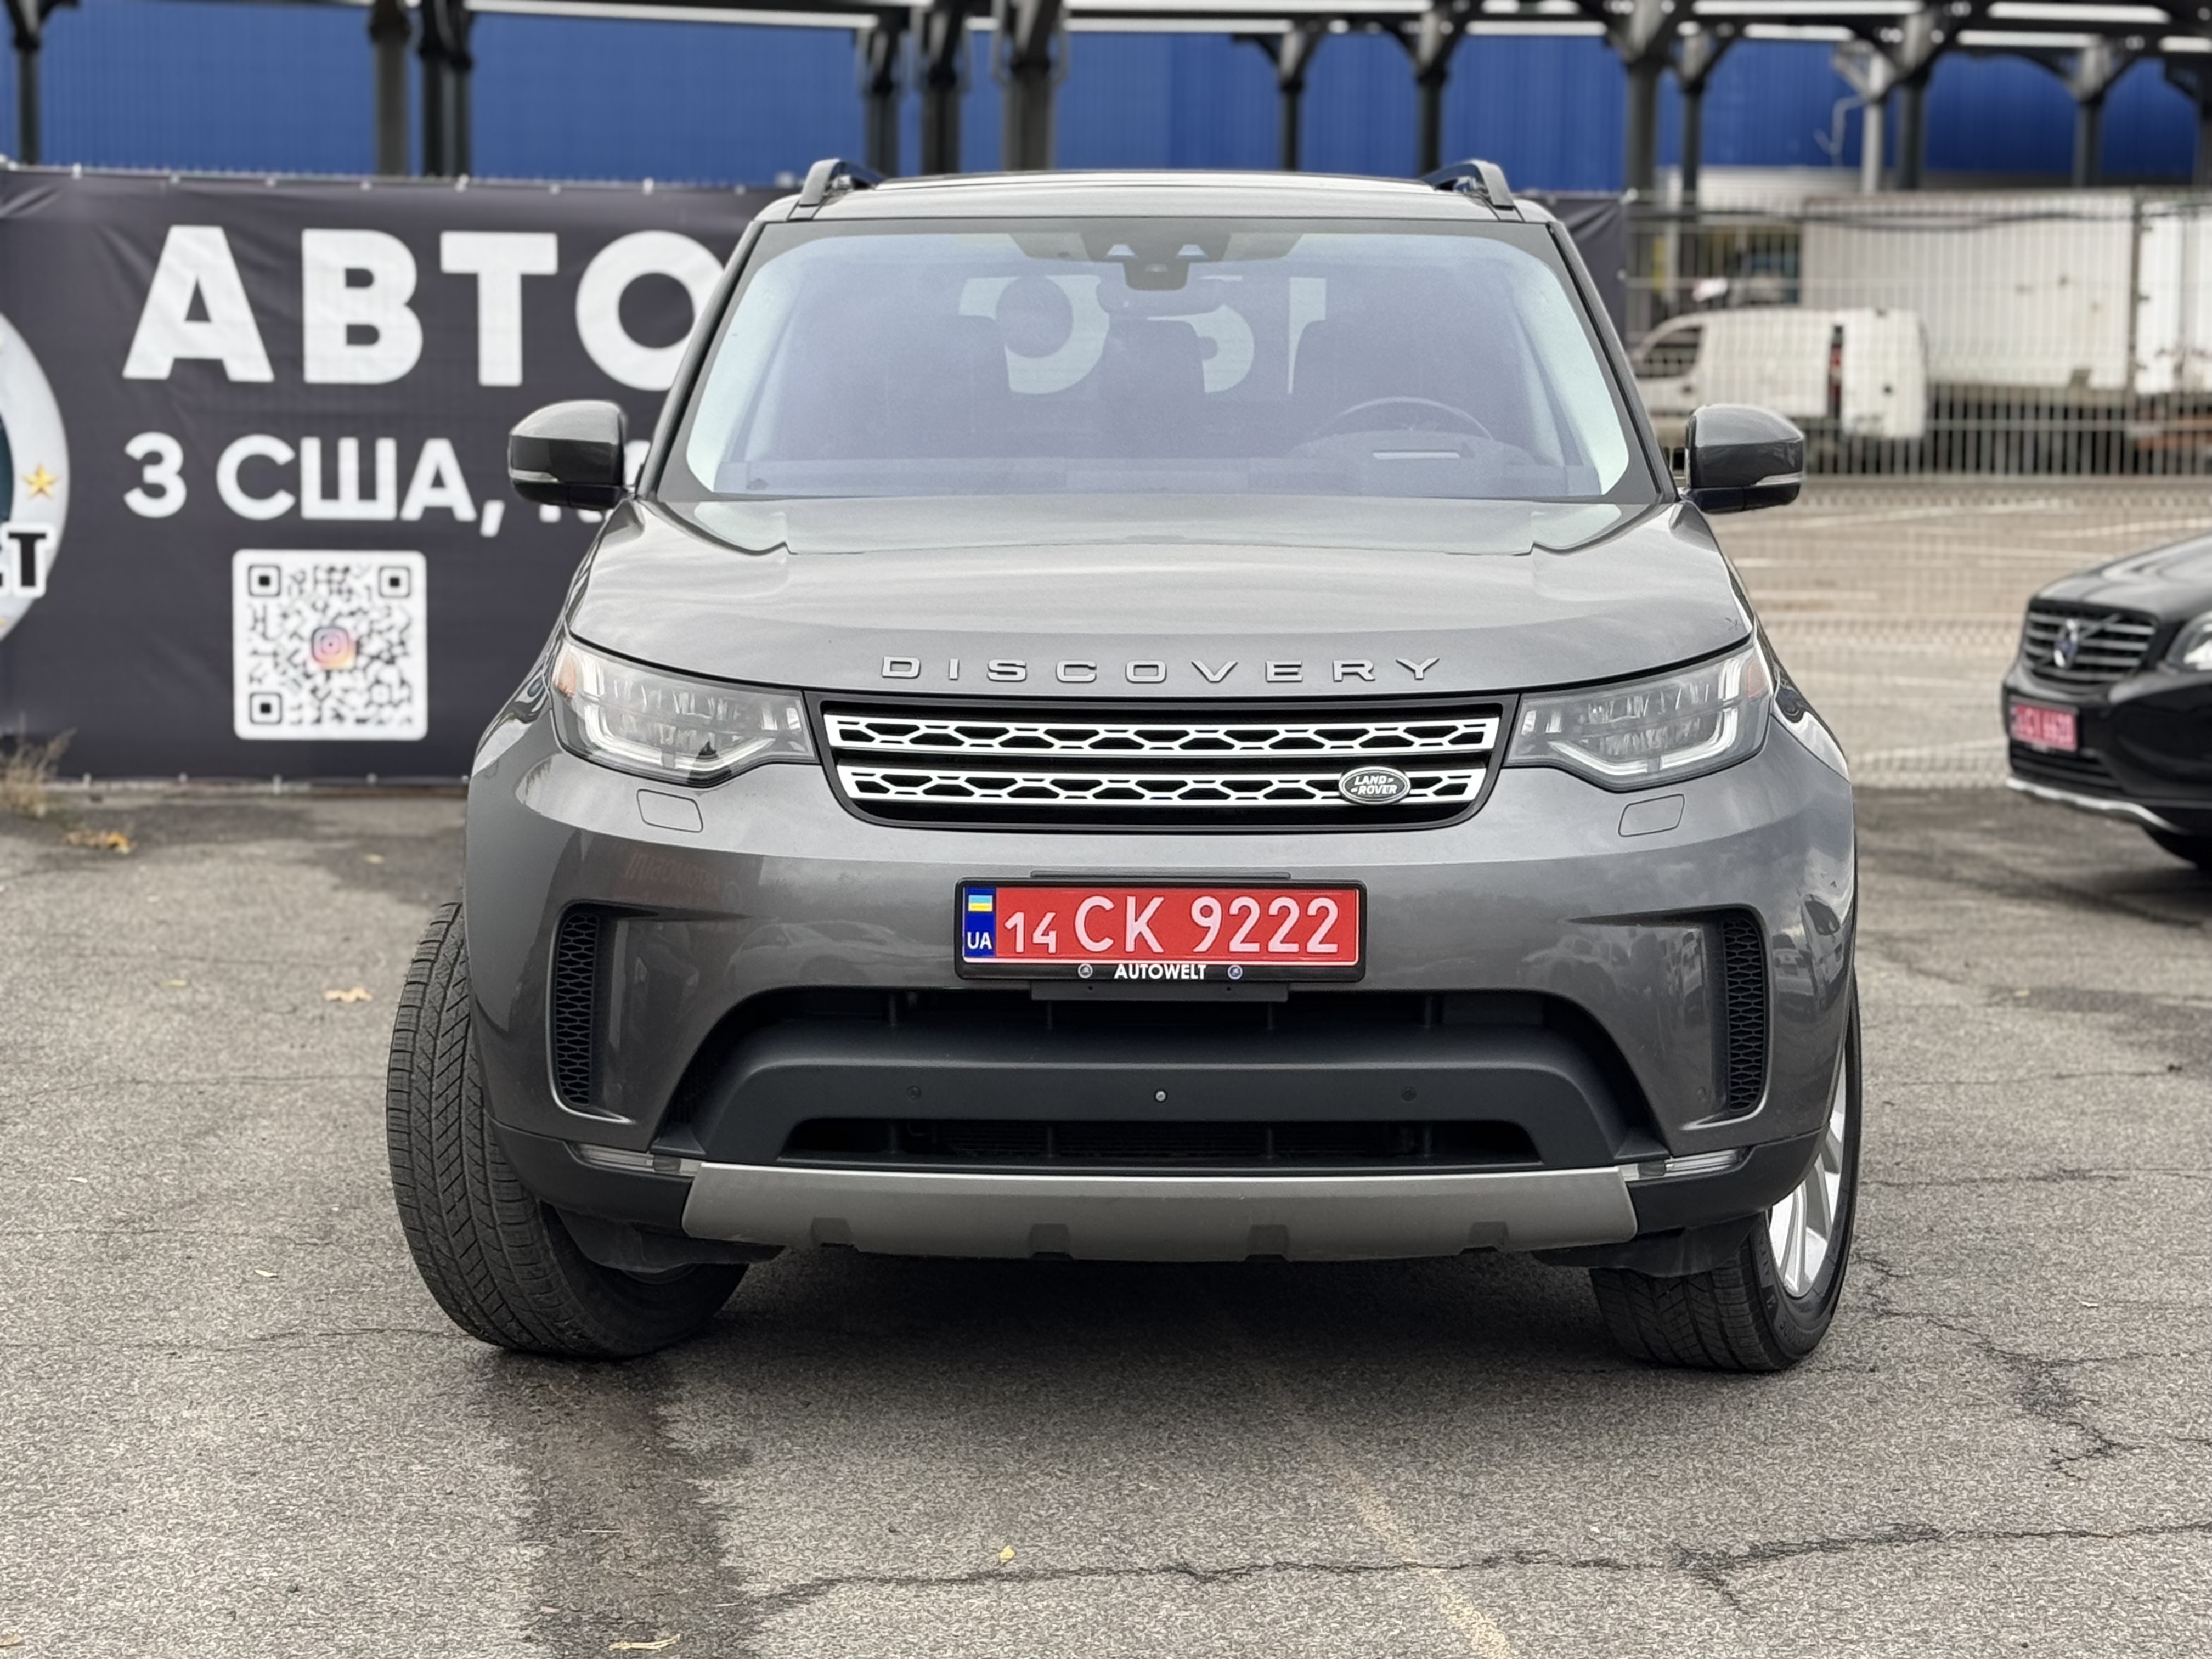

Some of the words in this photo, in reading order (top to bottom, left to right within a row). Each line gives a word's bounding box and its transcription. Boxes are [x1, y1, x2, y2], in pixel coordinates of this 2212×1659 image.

[216, 433, 505, 537] США,
[881, 656, 1440, 684] DISCOVERY
[1354, 775, 1387, 785] LAND
[1358, 785, 1397, 795] ROVER
[1190, 896, 1338, 953] 9222
[967, 932, 992, 949] UA
[1113, 963, 1206, 980] AUTOWELT
